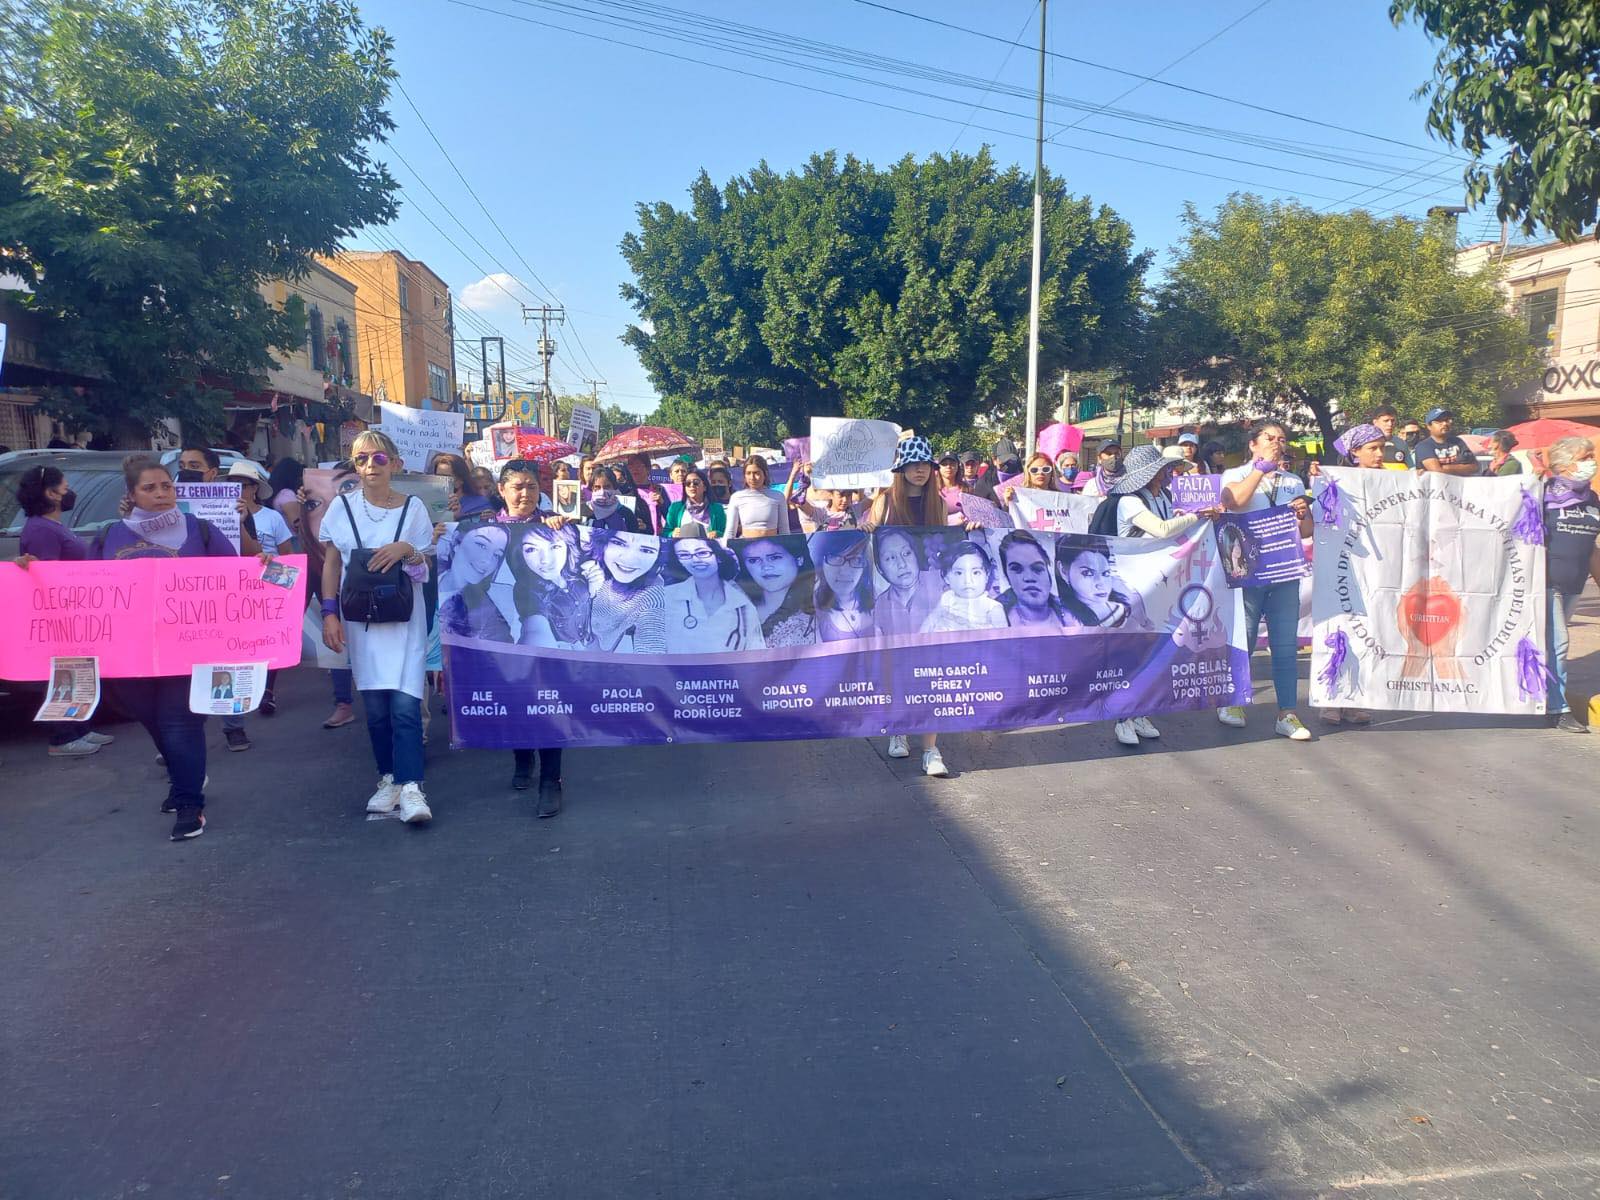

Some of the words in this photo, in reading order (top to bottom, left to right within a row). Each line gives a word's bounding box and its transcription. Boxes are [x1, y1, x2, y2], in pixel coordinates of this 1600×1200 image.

[1177, 477, 1212, 491] FALTA
[188, 485, 240, 498] CERVANTES
[1180, 491, 1217, 503] GUADALUPE
[1366, 488, 1446, 520] ESPERANZA
[1447, 494, 1485, 519] PARA
[1344, 529, 1360, 548] FE
[1489, 514, 1525, 584] VÍCTIMAS
[1337, 549, 1352, 571] DE
[165, 572, 227, 593] JUSTICIA
[33, 585, 104, 611] OLEGARIO
[1508, 589, 1525, 618] DEL
[163, 597, 217, 625] SILVIA
[225, 592, 285, 623] GÓMEZ
[1335, 575, 1387, 661] ASOCIACIÓN
[30, 613, 112, 643] FEMINICIDA
[178, 628, 225, 642] AGRESOR
[226, 635, 276, 656] Olegario
[1473, 621, 1517, 666] DELITO
[913, 667, 944, 677] EMMA
[946, 662, 988, 677] GARCÍA
[1096, 668, 1123, 679] KARLA
[1171, 663, 1196, 677] POR
[1198, 659, 1232, 674] ELLAS,
[675, 679, 740, 691] SAMANTHA
[930, 677, 963, 690] PÉREZ
[1028, 673, 1067, 685] NATALY
[1089, 680, 1131, 692] PONTIGO
[1172, 678, 1190, 689] POR
[1191, 674, 1233, 686] NOSOTRAS
[602, 688, 643, 699] PAOLA
[762, 684, 808, 696] ODALYS
[839, 681, 874, 693] LUPITA
[1028, 686, 1069, 698] ALONSO
[1180, 687, 1201, 698] POR
[1202, 683, 1236, 696] TODAS
[471, 691, 493, 701] ALE
[537, 689, 560, 700] FER
[679, 693, 734, 705] JOCELYN
[824, 694, 892, 707] VIRAMONTES
[904, 694, 953, 705] VICTORIA
[954, 692, 1004, 703] ANTONIO
[461, 703, 508, 716] GARCÍA
[526, 701, 573, 715] MORÁN
[590, 702, 655, 714] GUERRERO
[762, 697, 814, 710] HIPOLITO
[933, 703, 975, 717] GARCÍA
[674, 705, 742, 719] RODRÍGUEZ
